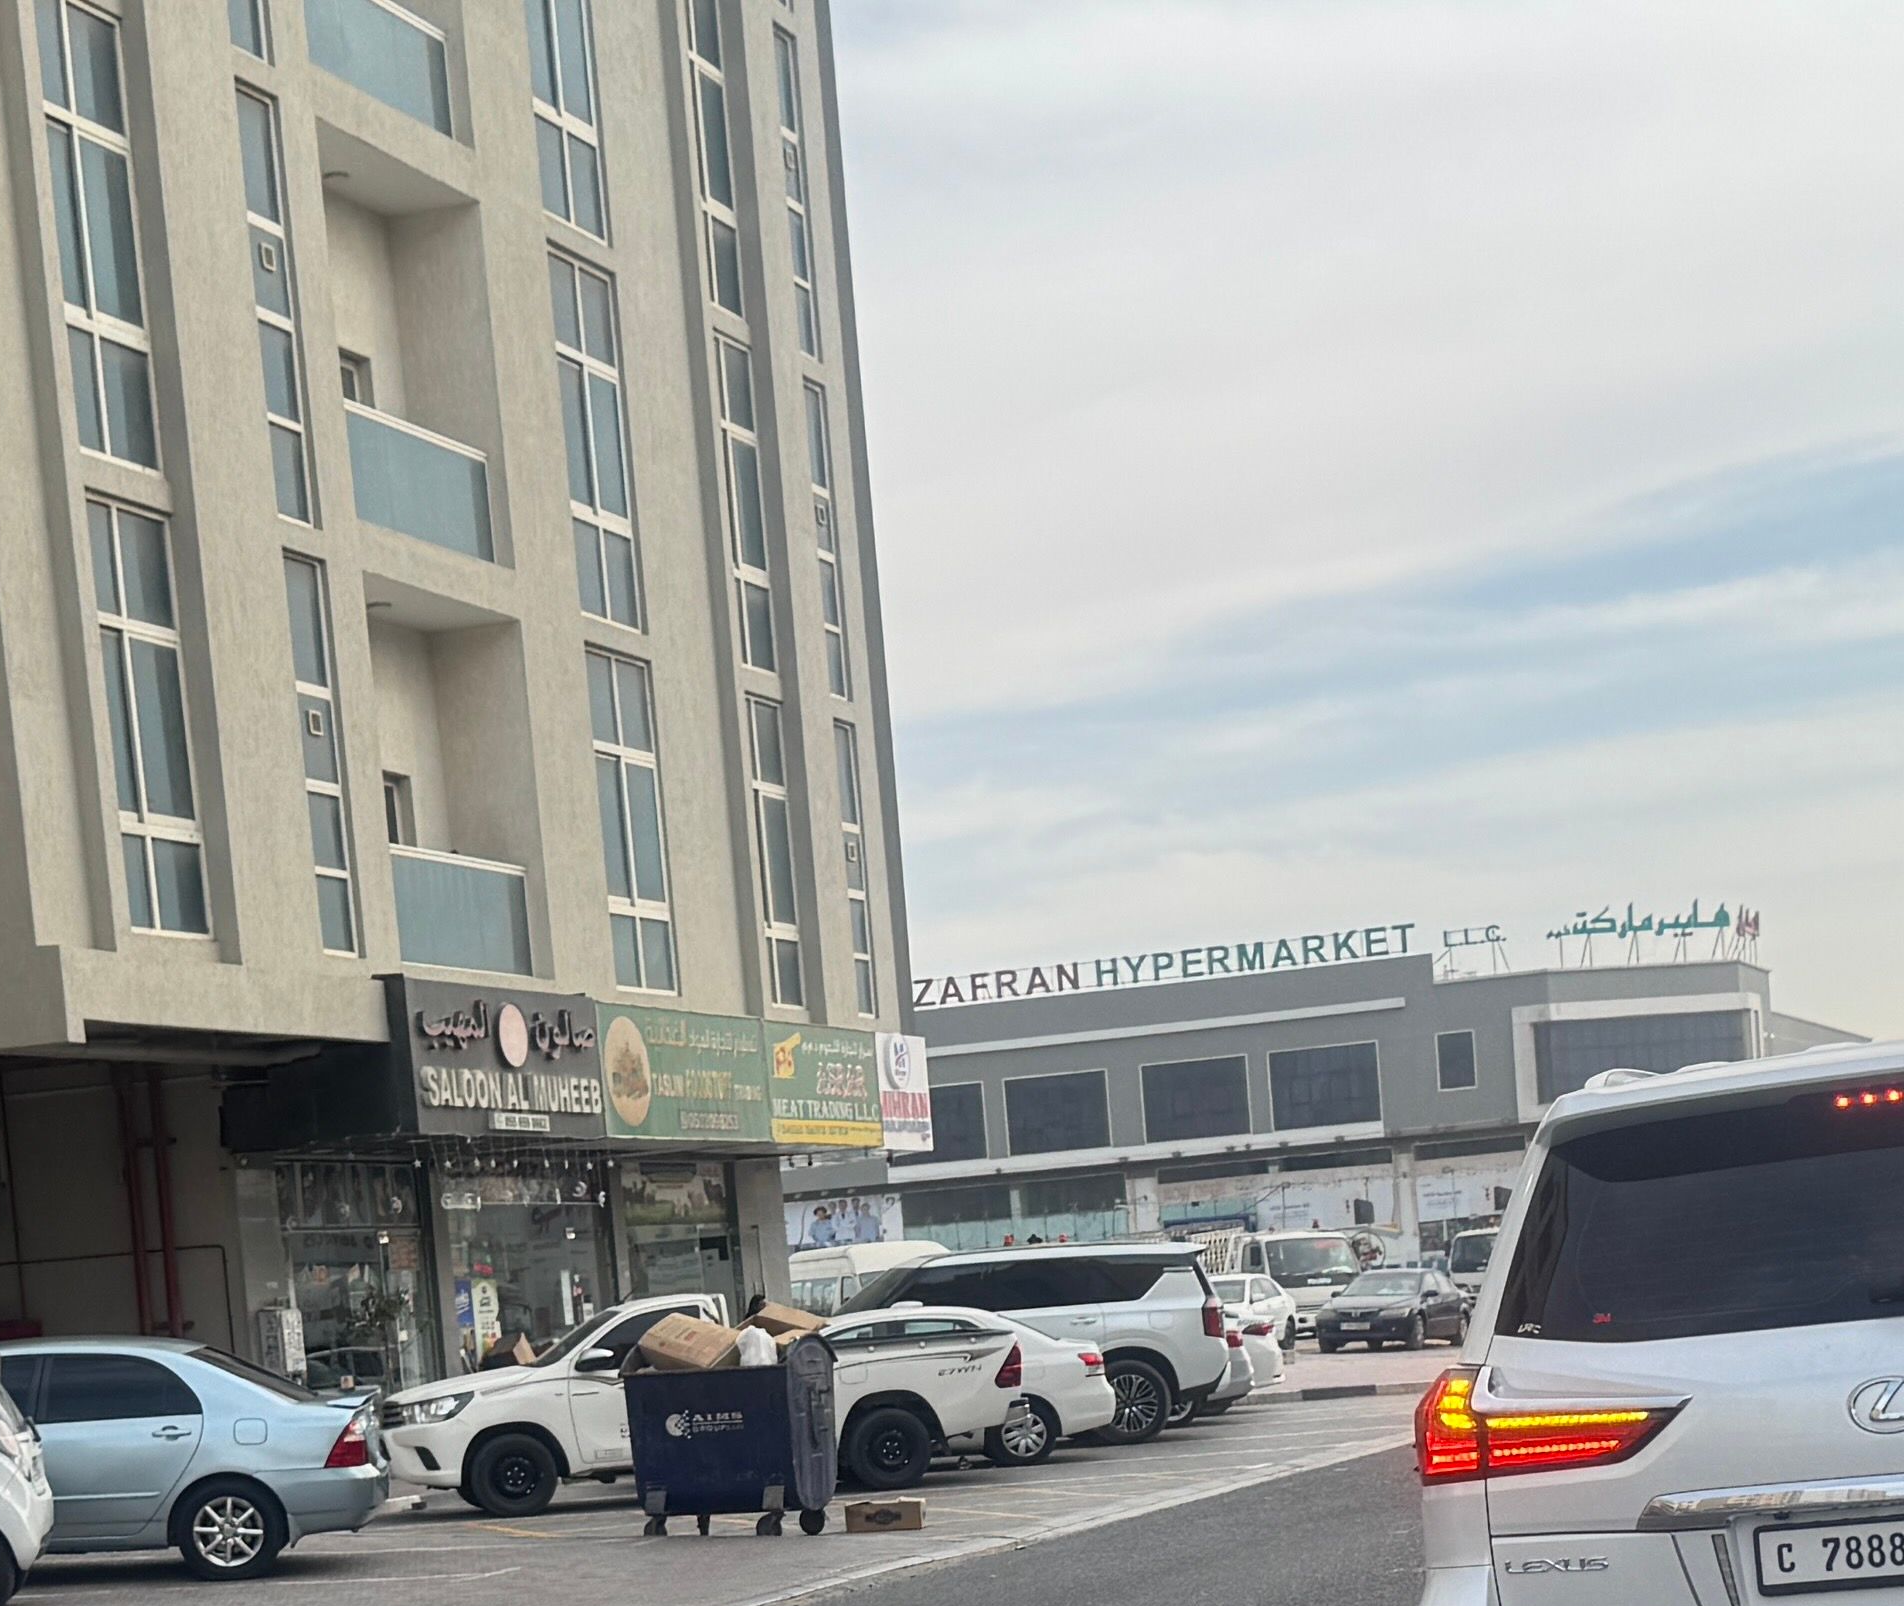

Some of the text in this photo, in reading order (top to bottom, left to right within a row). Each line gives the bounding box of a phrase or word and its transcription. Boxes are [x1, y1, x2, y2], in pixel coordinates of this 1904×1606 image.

[912, 961, 1081, 1008] ZAFRAN
[1095, 922, 1416, 988] HYPERMARKET
[530, 1007, 596, 1060] صالون
[422, 1067, 602, 1113] SALOON AL MUHEEB
[773, 1099, 804, 1119] MEAT
[807, 1100, 853, 1121] TRADING
[1505, 1555, 1609, 1574] LEXUS
[1777, 1542, 1795, 1573] C
